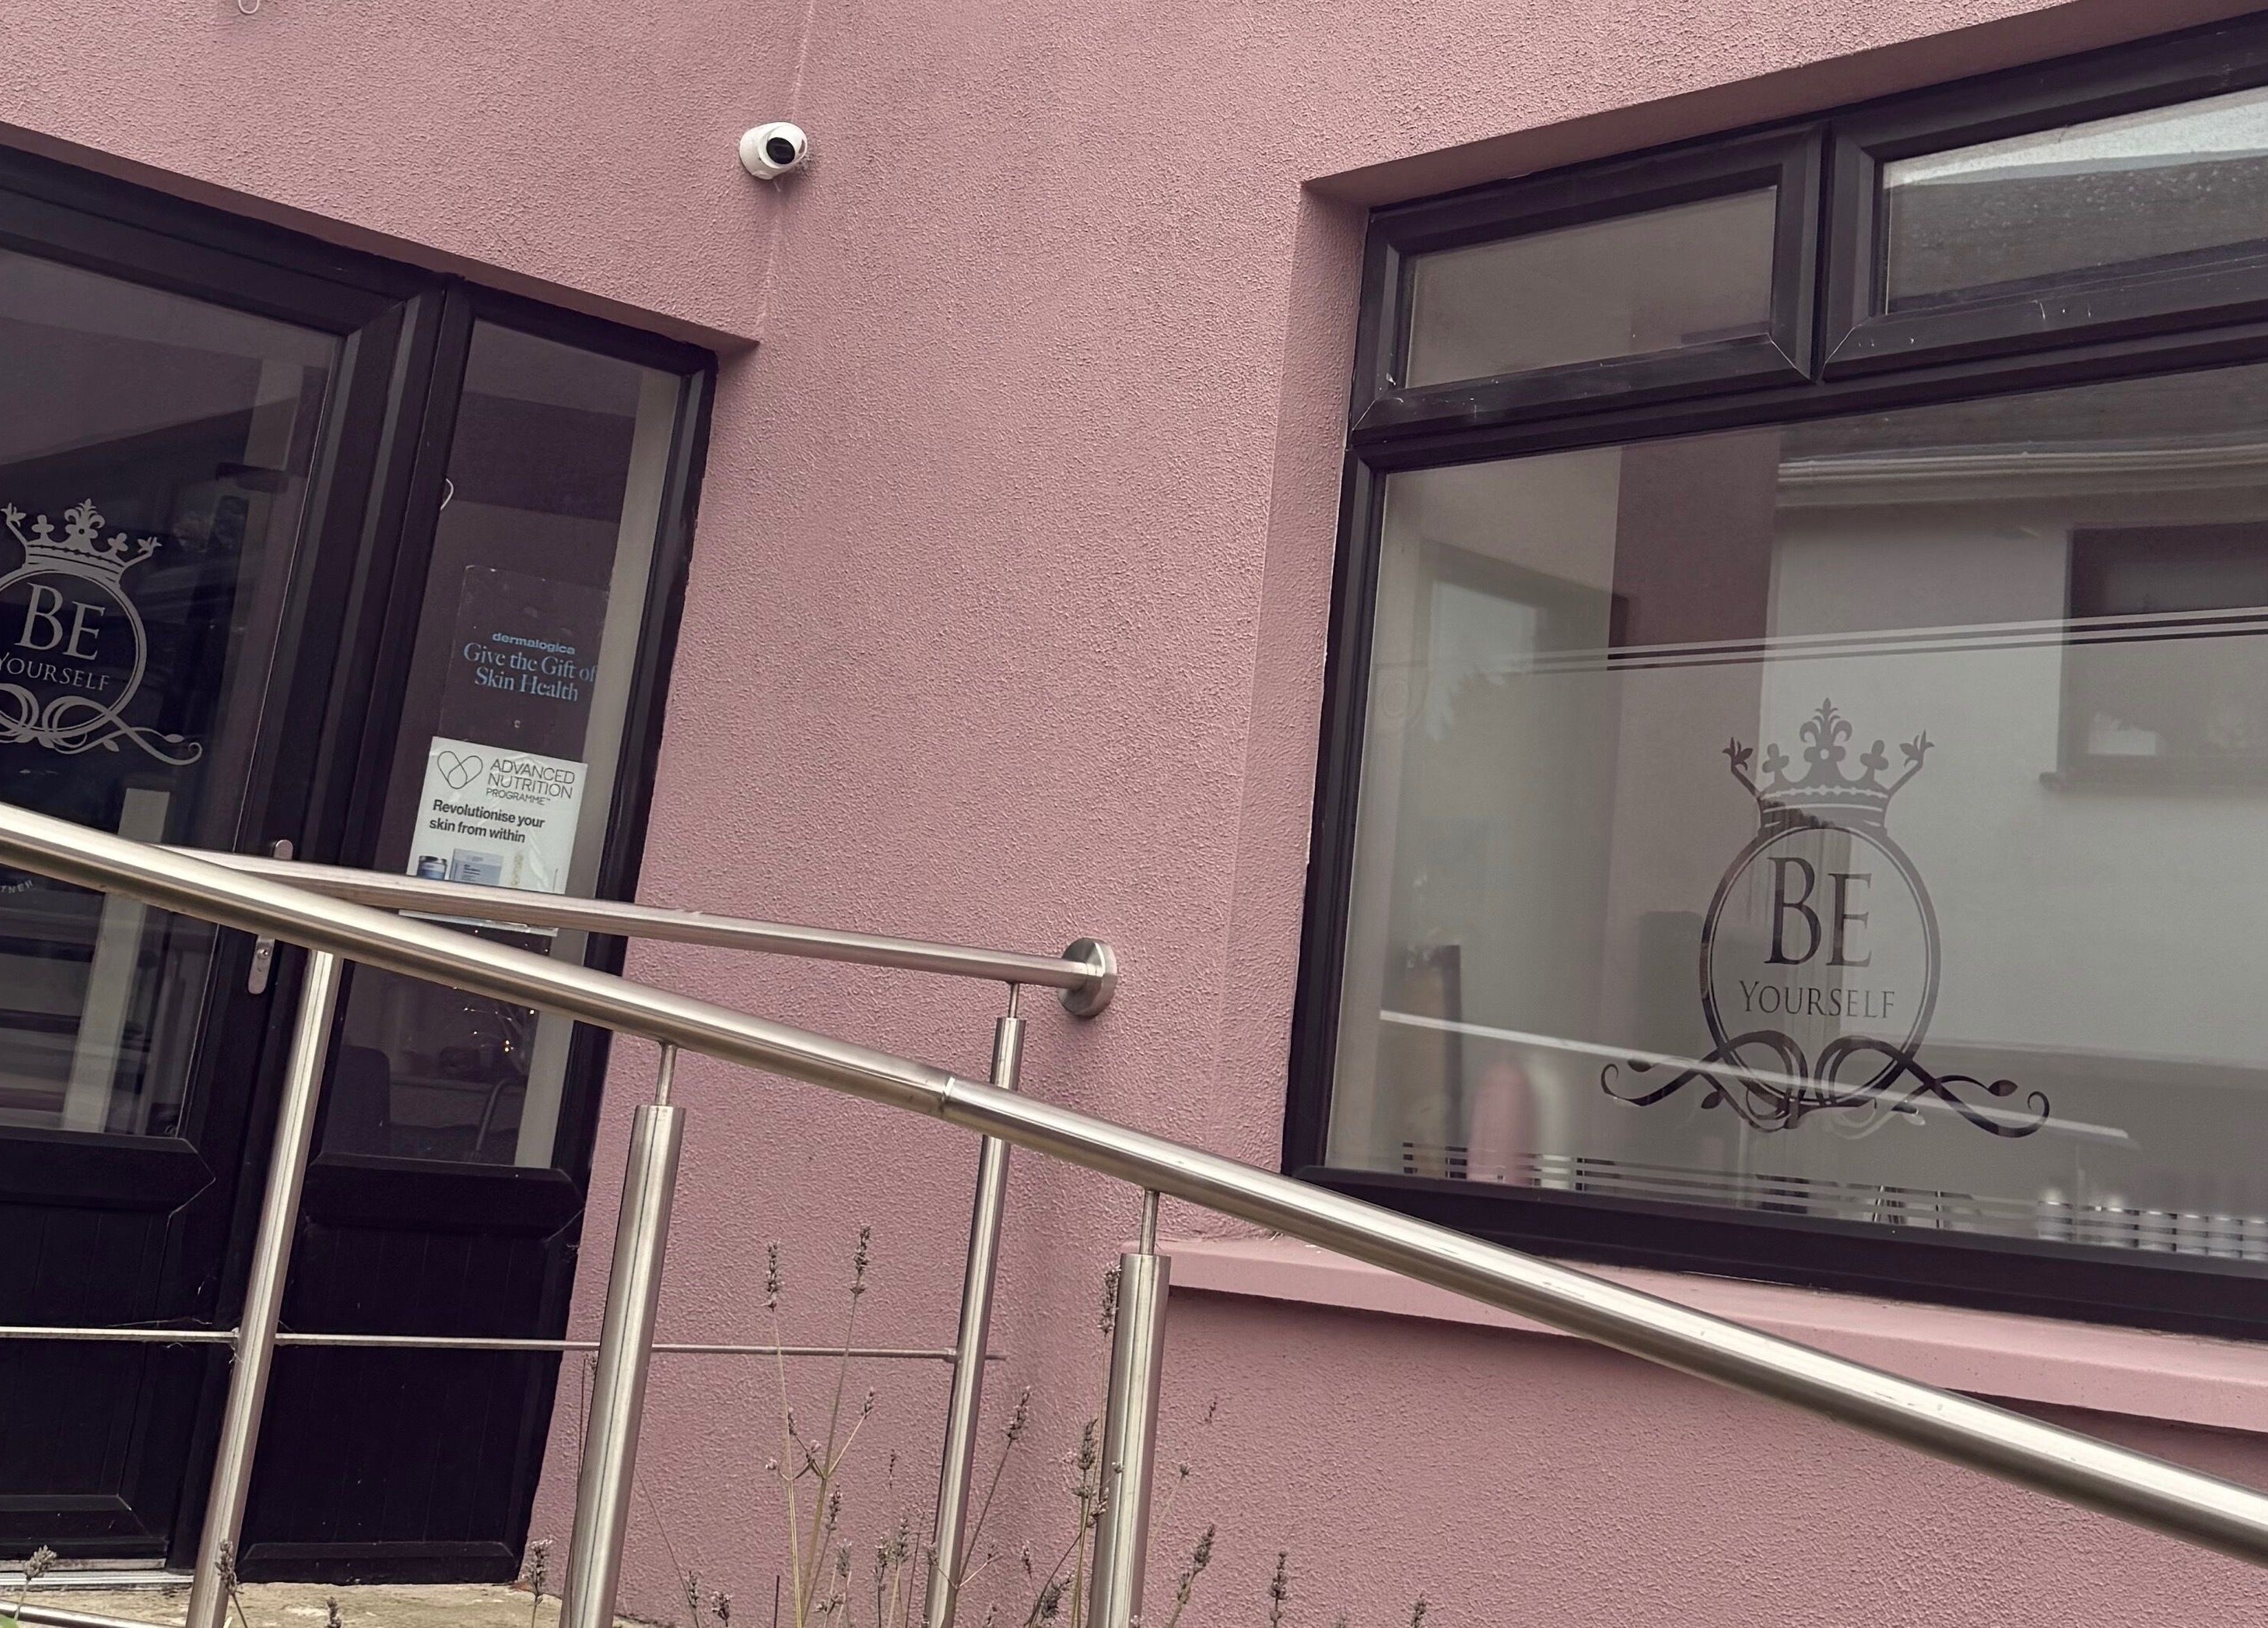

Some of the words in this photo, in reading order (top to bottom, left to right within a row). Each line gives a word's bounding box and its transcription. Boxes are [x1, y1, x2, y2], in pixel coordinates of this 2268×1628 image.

[15, 582, 106, 661] BE
[492, 632, 576, 655] dermalogica
[463, 642, 506, 666] Give
[510, 651, 537, 672] the
[541, 655, 577, 679] Gift
[579, 664, 598, 682] of
[475, 665, 515, 691] Skin
[518, 673, 579, 702] Health
[488, 773, 573, 798] NUTRITION
[490, 759, 575, 784] ADVANCED
[433, 798, 516, 823] Revolutionise
[516, 814, 546, 828] your
[429, 817, 455, 832] skin
[457, 821, 487, 837] from
[489, 828, 526, 843] within
[1764, 857, 1872, 967] BE
[1739, 981, 1895, 1019] YOURSELF
